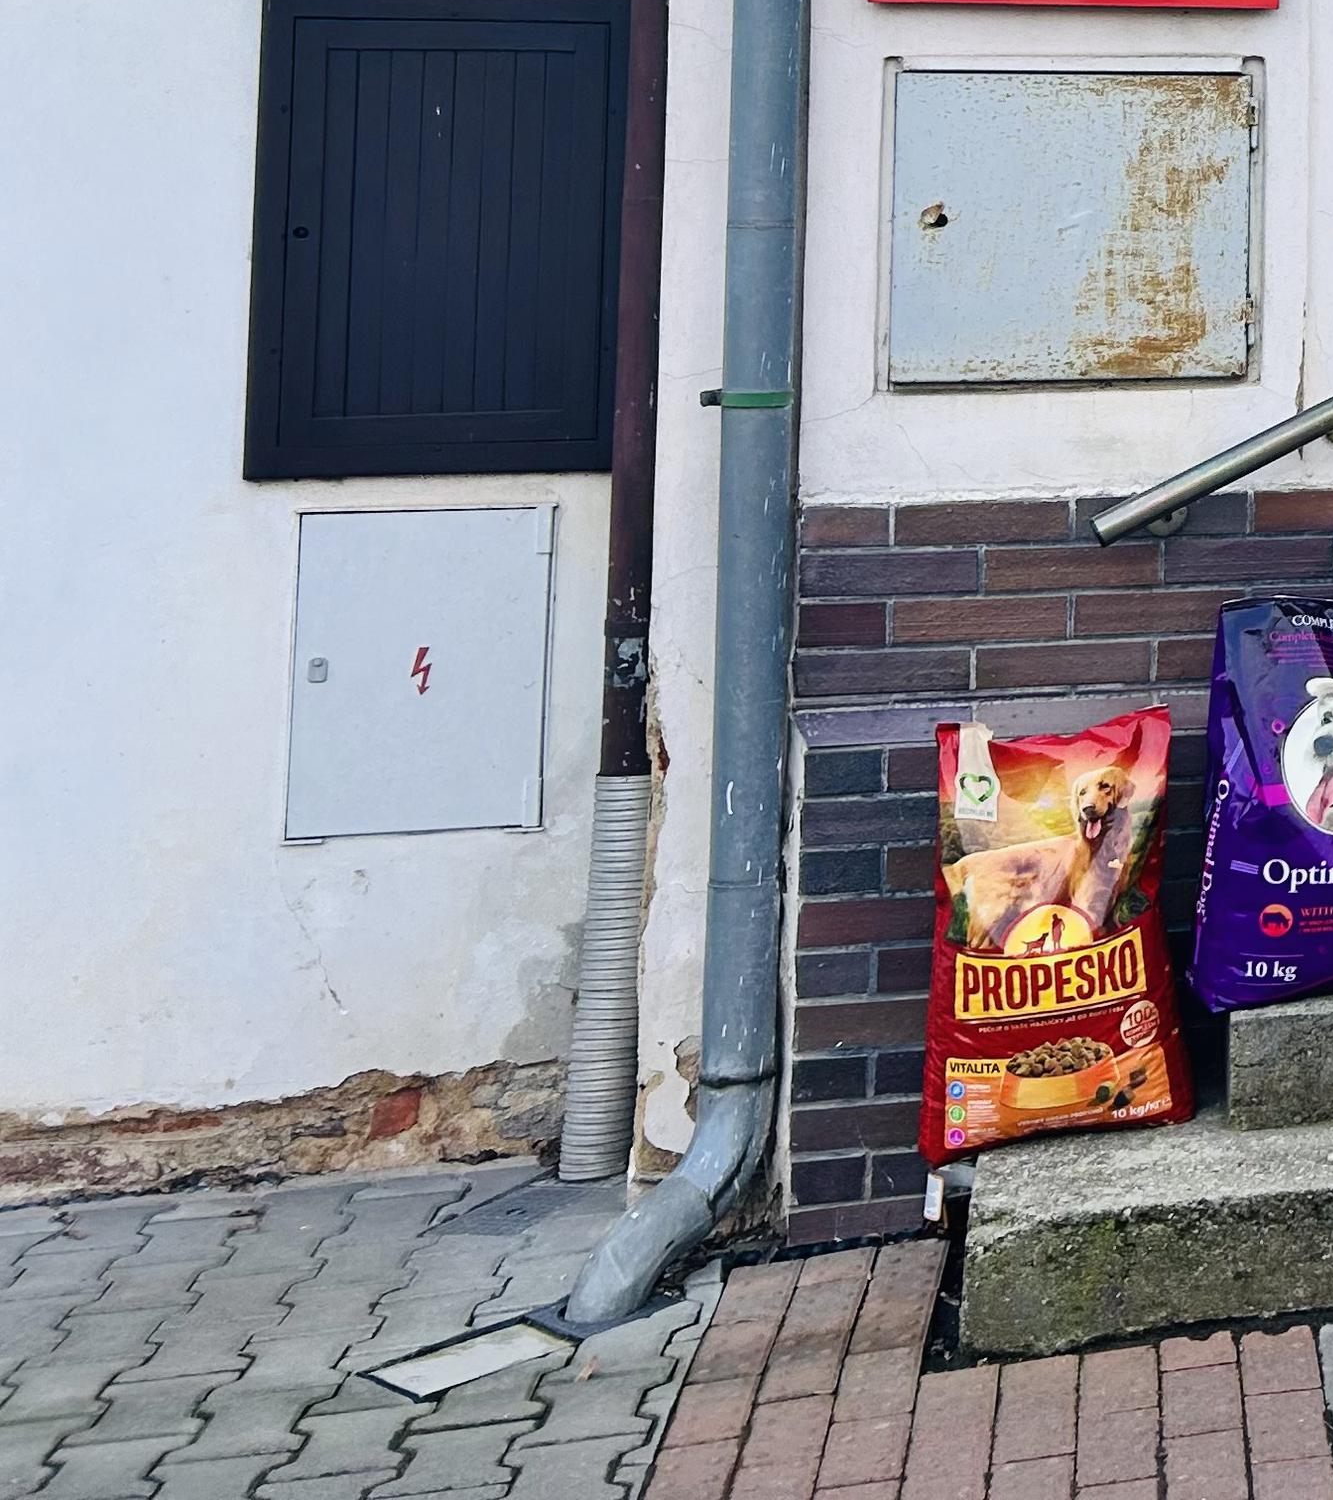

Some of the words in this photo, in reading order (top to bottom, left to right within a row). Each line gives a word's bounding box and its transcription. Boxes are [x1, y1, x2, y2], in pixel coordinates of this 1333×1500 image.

[962, 939, 1138, 1013] PROPESKO
[1244, 961, 1268, 978] 10
[1273, 961, 1297, 982] kg
[950, 1063, 1000, 1074] VITALITA
[1112, 1110, 1127, 1119] 10
